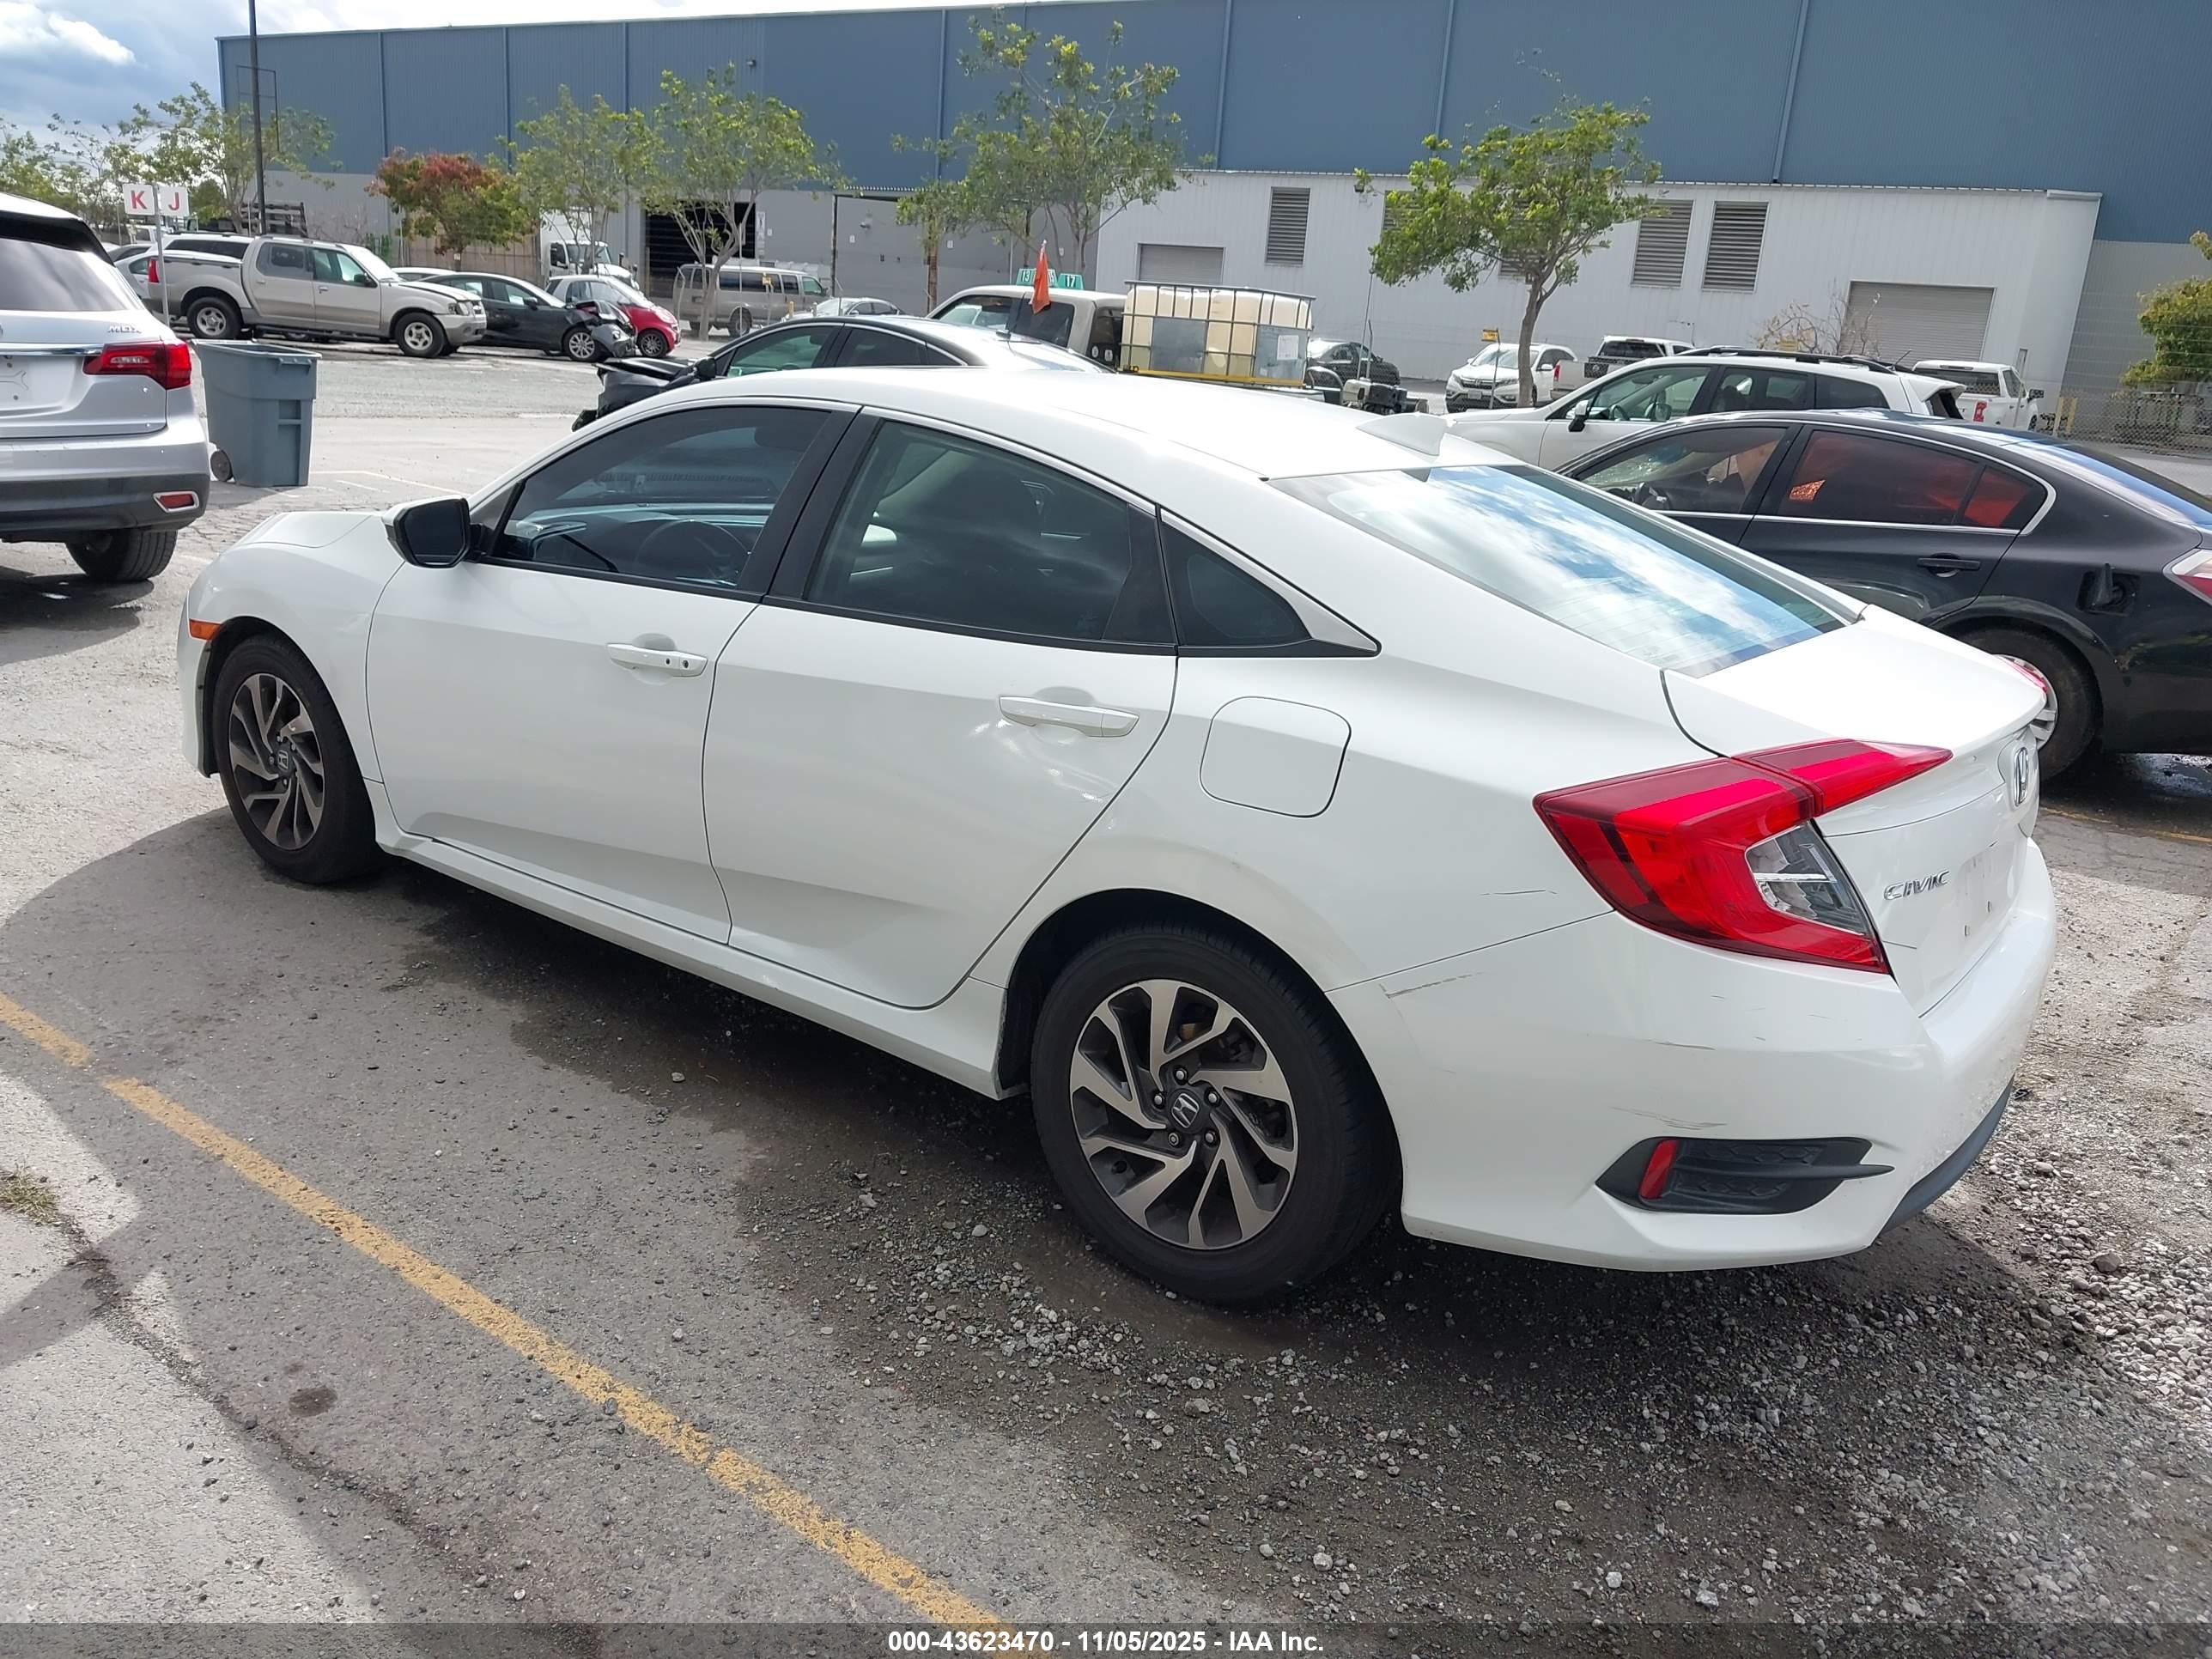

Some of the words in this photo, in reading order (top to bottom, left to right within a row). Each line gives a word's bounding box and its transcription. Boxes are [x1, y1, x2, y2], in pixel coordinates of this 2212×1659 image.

[131, 190, 148, 210] K
[168, 191, 180, 211] J
[1022, 270, 1030, 283] 13
[1066, 275, 1076, 288] 17
[107, 323, 143, 334] MDX
[1884, 869, 1950, 901] CIVIC
